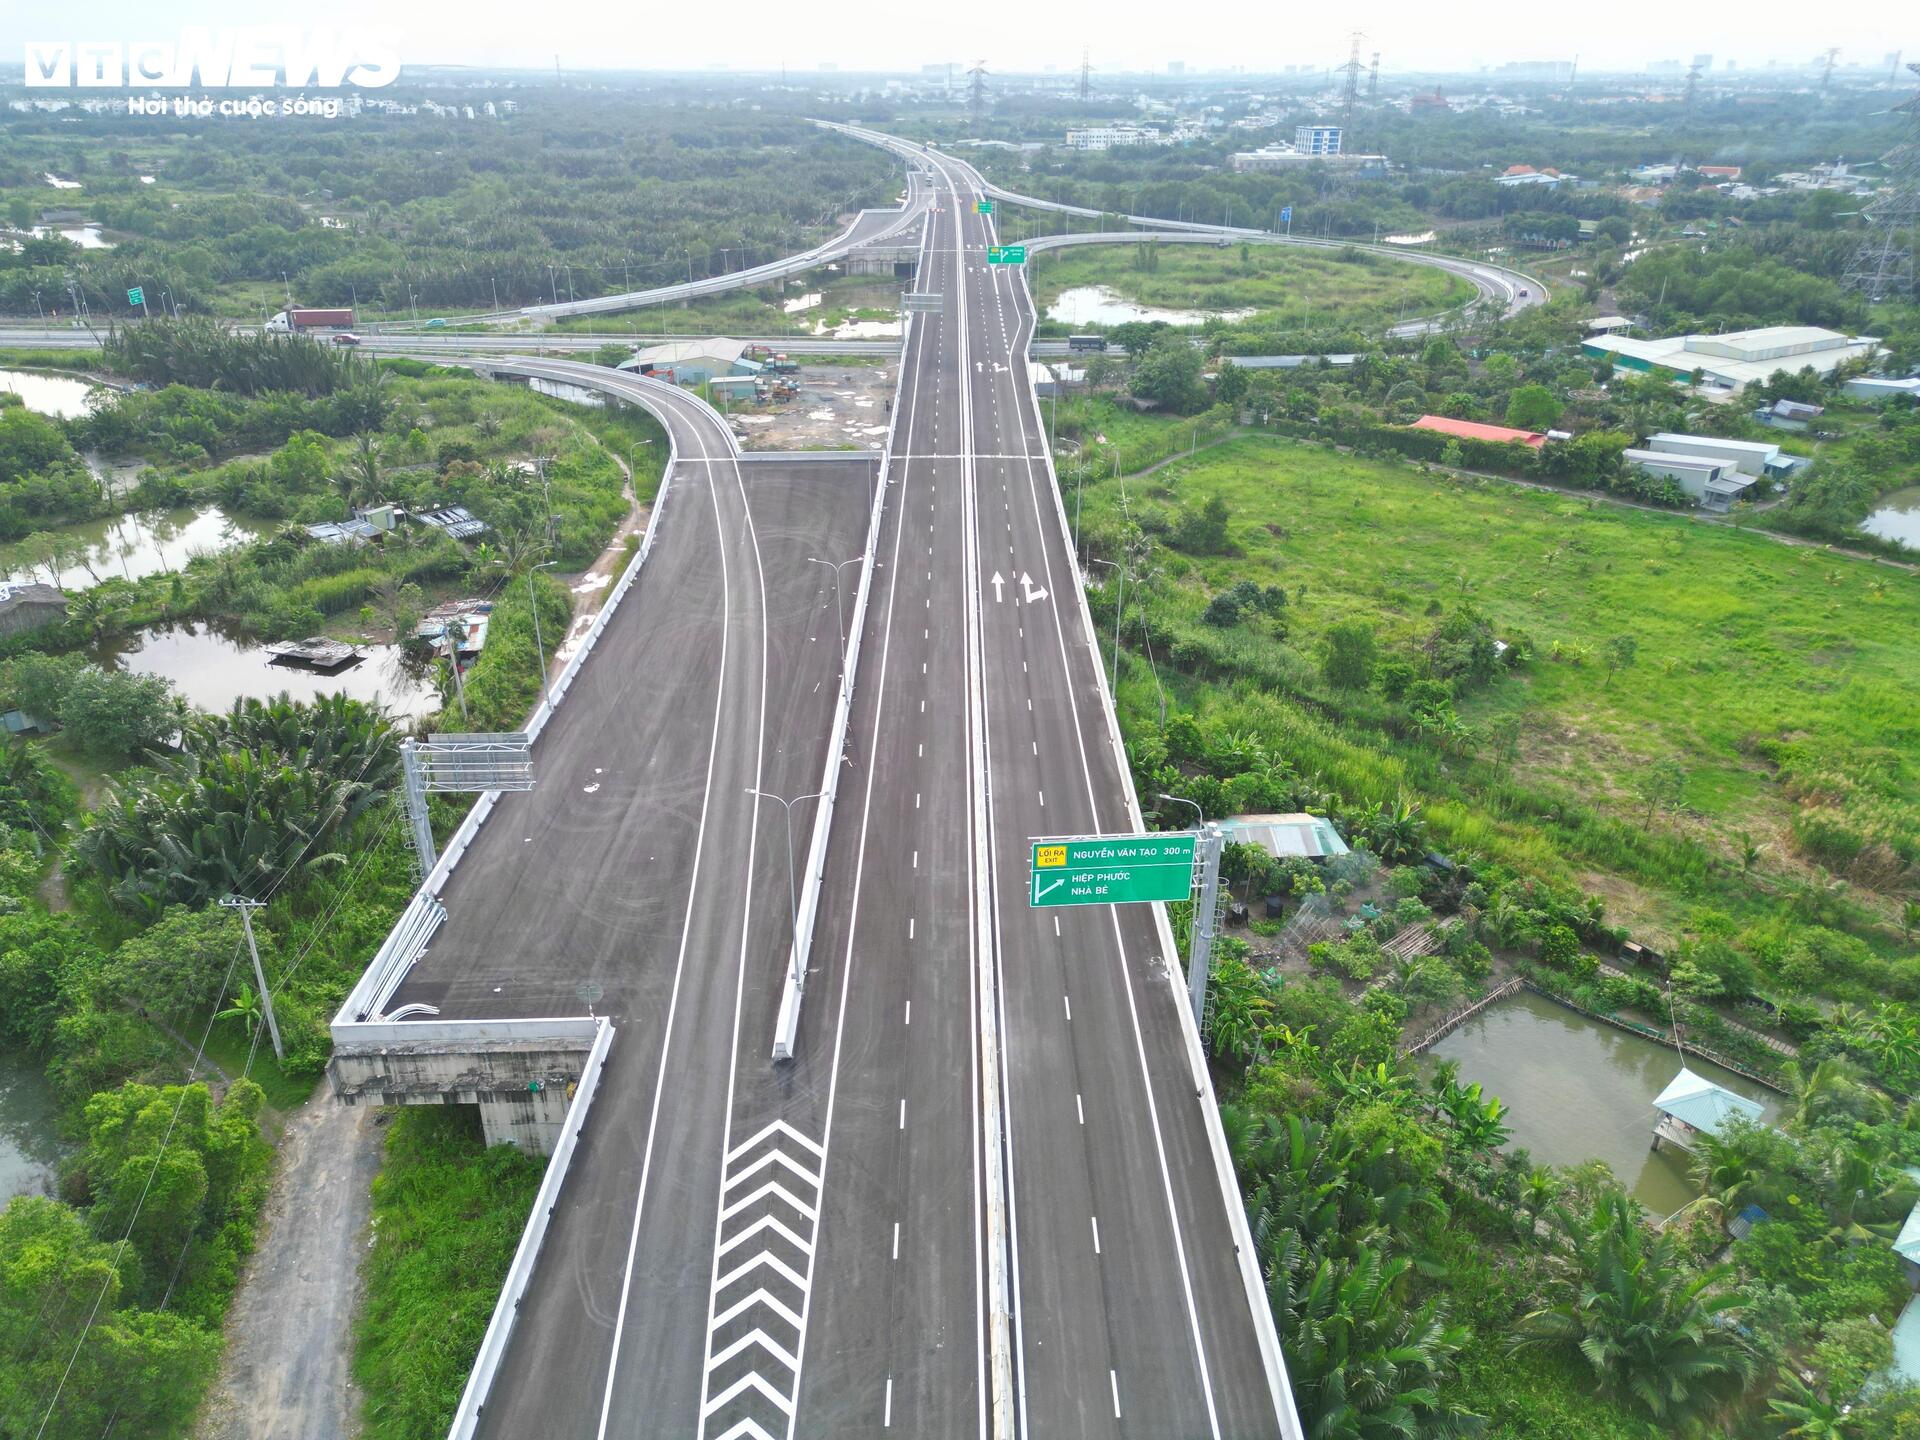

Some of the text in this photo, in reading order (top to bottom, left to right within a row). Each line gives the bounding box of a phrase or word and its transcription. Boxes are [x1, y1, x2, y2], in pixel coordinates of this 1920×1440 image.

[1038, 848, 1065, 857] LỐI RA
[1073, 847, 1115, 859] NGUYỄN
[1117, 847, 1136, 857] VĂN
[1140, 848, 1157, 857] TẠO
[1163, 847, 1181, 855] 300
[1072, 871, 1131, 884] HIỆP PHƯỚC
[1072, 885, 1109, 896] NHÀ BÈ
